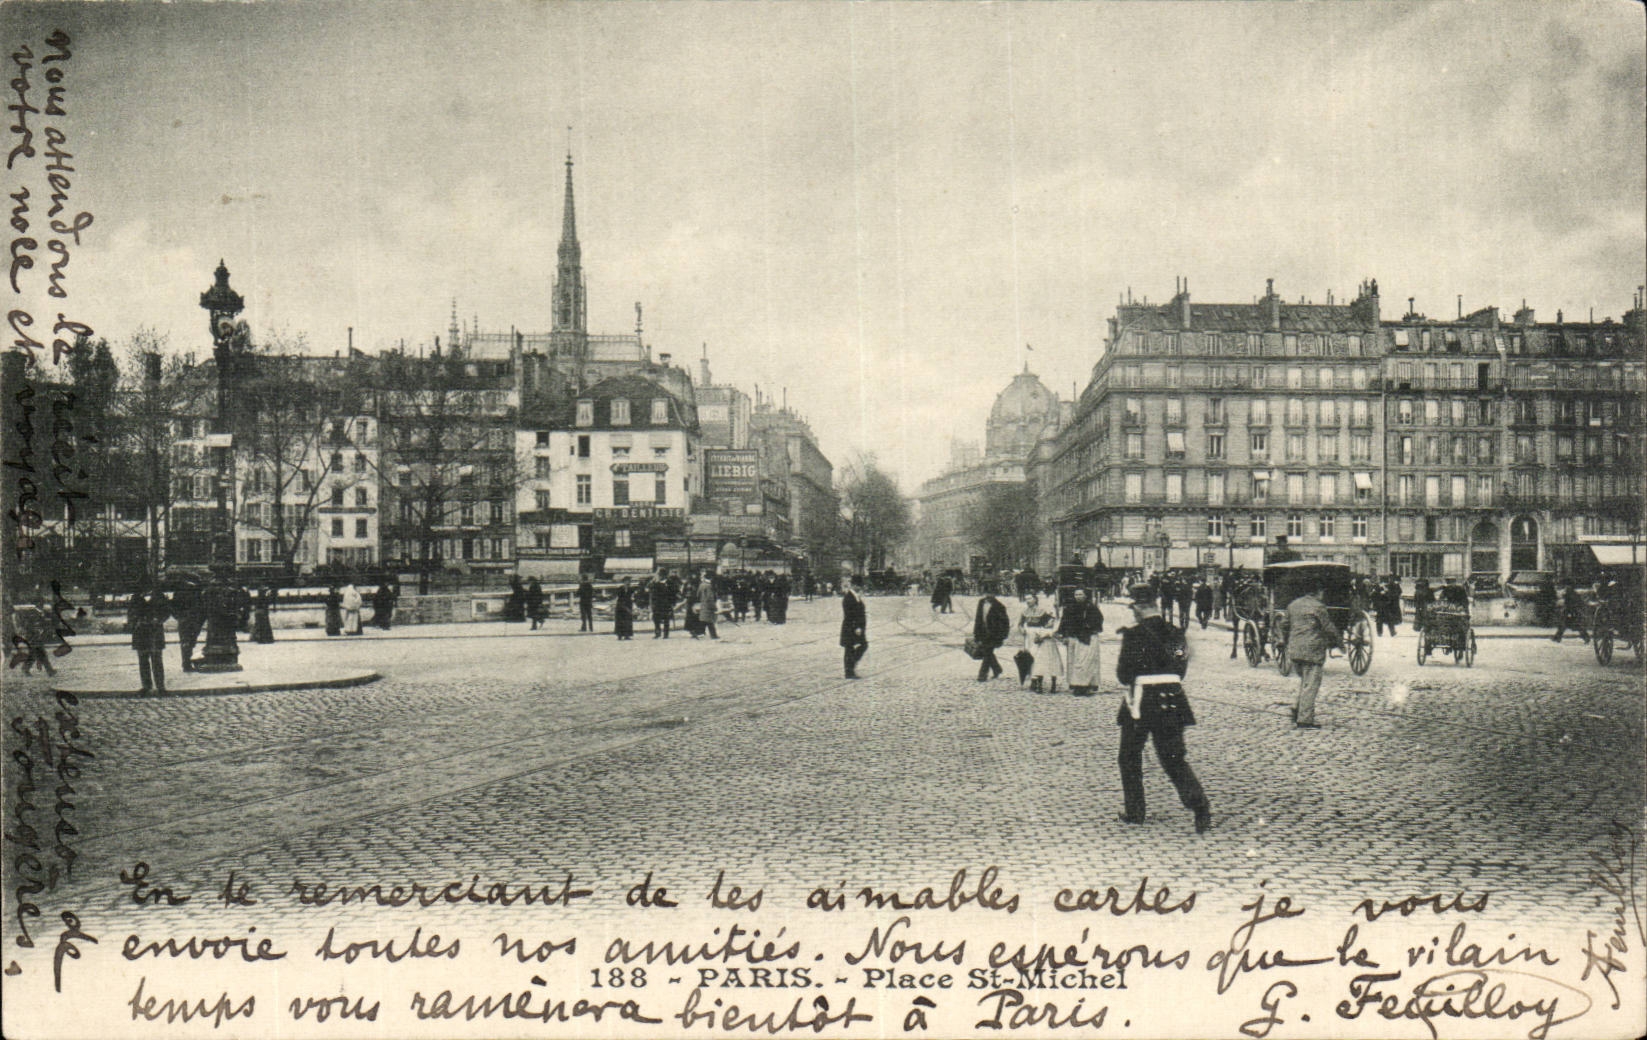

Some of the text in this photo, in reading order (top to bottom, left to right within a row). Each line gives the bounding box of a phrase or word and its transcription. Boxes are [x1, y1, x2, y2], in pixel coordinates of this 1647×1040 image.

[6, 45, 39, 170] votre
[43, 126, 94, 298] attendons
[710, 465, 756, 478] LIEBIG
[119, 861, 192, 907] En
[288, 872, 594, 908] remerciant
[626, 871, 678, 909] de
[806, 866, 1020, 913] aimables
[1053, 876, 1198, 916] cartes
[1232, 880, 1306, 945] je
[1351, 889, 1492, 919] vous
[53, 910, 99, 994] de
[121, 926, 288, 962] envoie
[313, 928, 462, 965] toutes
[492, 931, 577, 960] nos
[845, 916, 966, 967] Nous
[1205, 943, 1334, 996] que
[1334, 924, 1382, 969] le
[1406, 922, 1559, 969] vilain
[128, 976, 256, 1029] temps
[288, 994, 381, 1024] vous
[410, 975, 666, 1026] ramènera
[675, 988, 874, 1034] bientôt
[902, 997, 938, 1032] à
